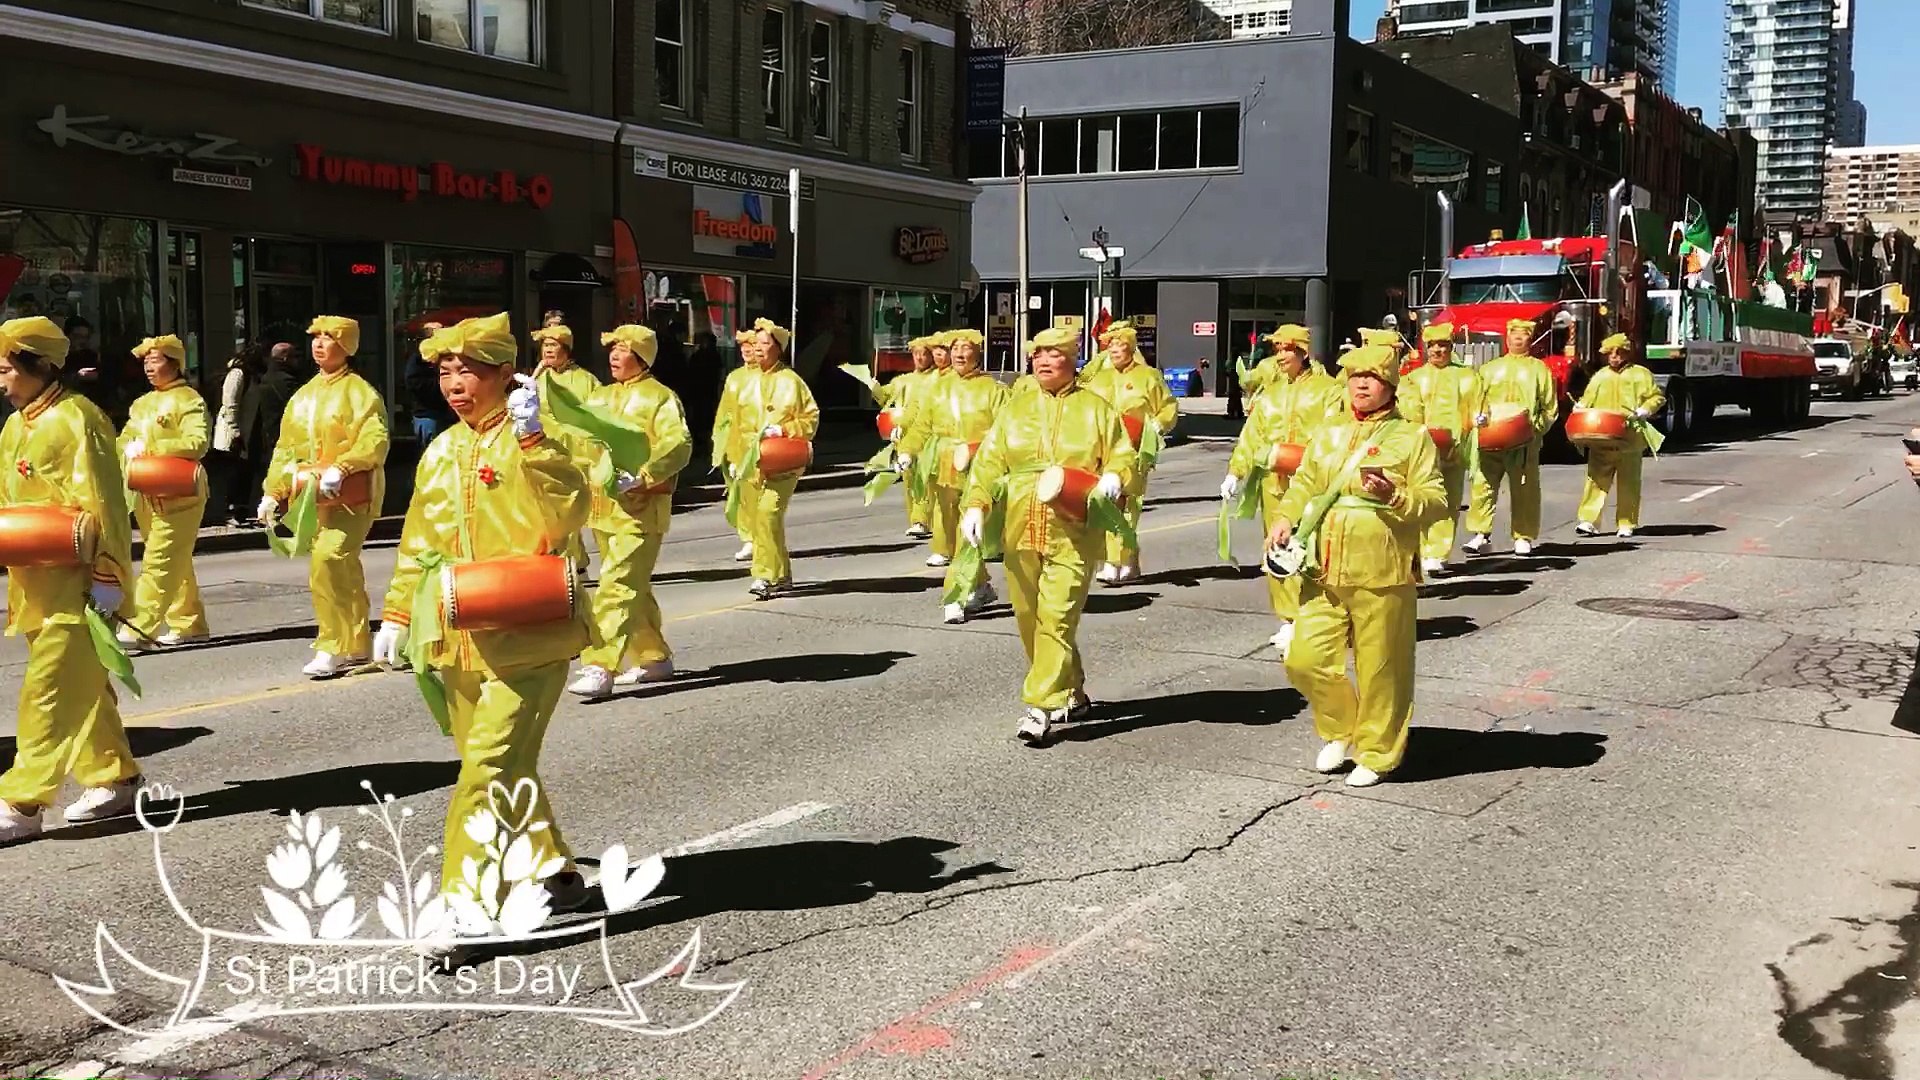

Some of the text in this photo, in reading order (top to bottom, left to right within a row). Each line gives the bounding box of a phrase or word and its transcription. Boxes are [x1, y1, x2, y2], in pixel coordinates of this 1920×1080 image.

[230, 177, 251, 188] HOUSE
[295, 143, 555, 211] Yummy Bar-B-Q
[672, 161, 695, 178] FOR
[697, 165, 728, 183] LEASE
[729, 171, 748, 186] 416
[750, 174, 768, 189] 362
[770, 177, 793, 192] 224
[694, 209, 777, 243] Freedom
[351, 263, 377, 275] OPEN
